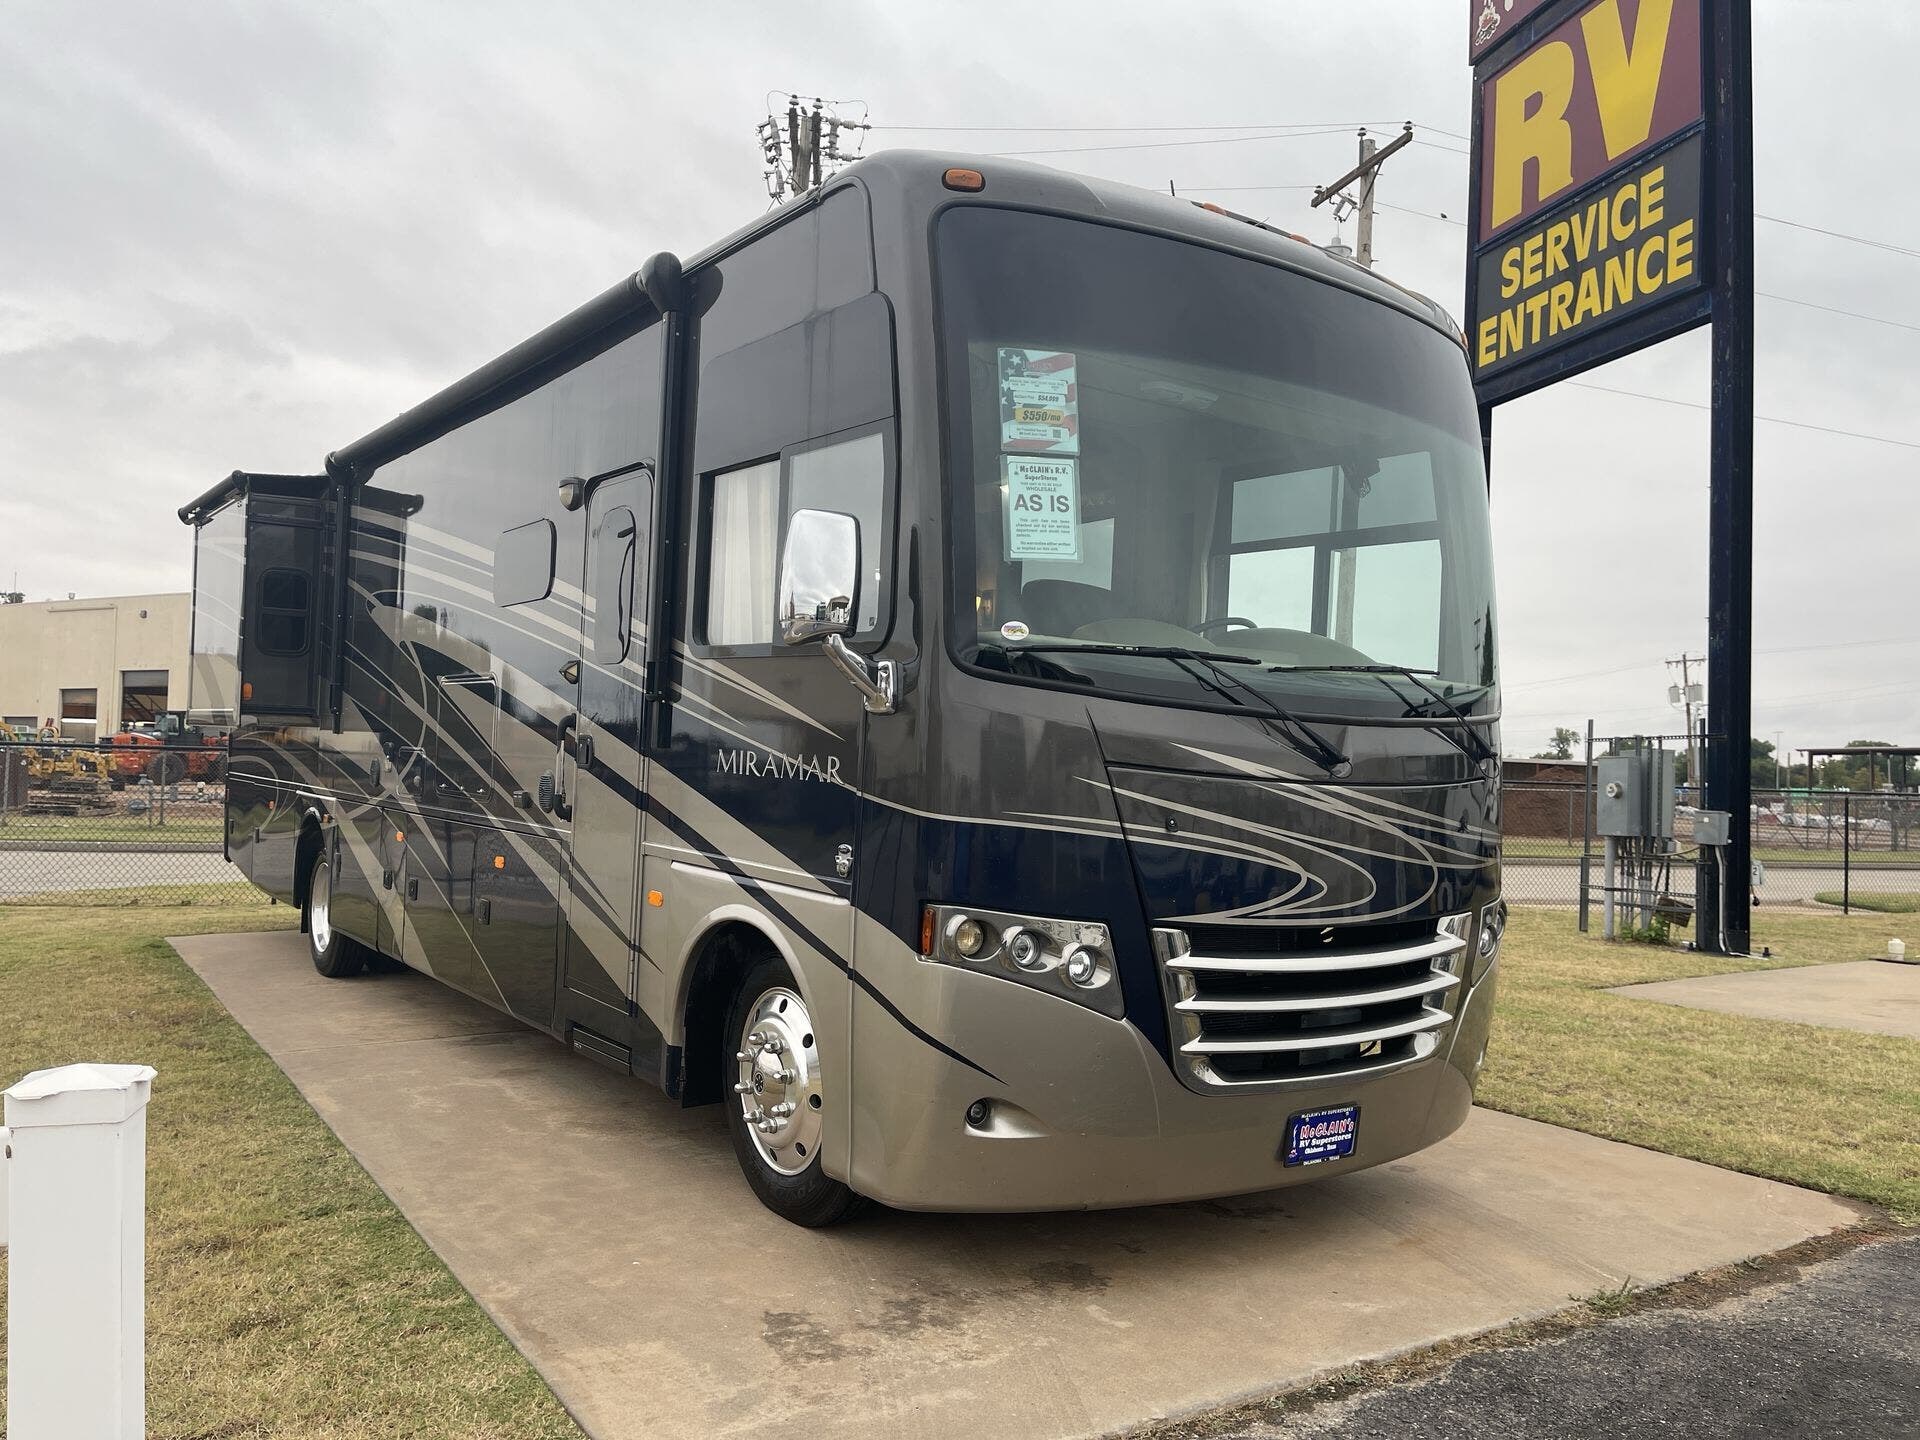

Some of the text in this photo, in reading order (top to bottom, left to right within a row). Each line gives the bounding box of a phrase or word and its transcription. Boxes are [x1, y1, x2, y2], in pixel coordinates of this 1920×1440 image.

[1492, 0, 1674, 229] RV
[1501, 166, 1664, 299] SERVICE
[1479, 219, 1694, 368] ENTRANCE
[1022, 410, 1061, 422] $550/mo
[1014, 494, 1070, 513] AS IS
[716, 749, 846, 785] MIRAMAR
[1299, 1133, 1352, 1148] RV Superstores
[1300, 1117, 1354, 1139] McCLAIN's
